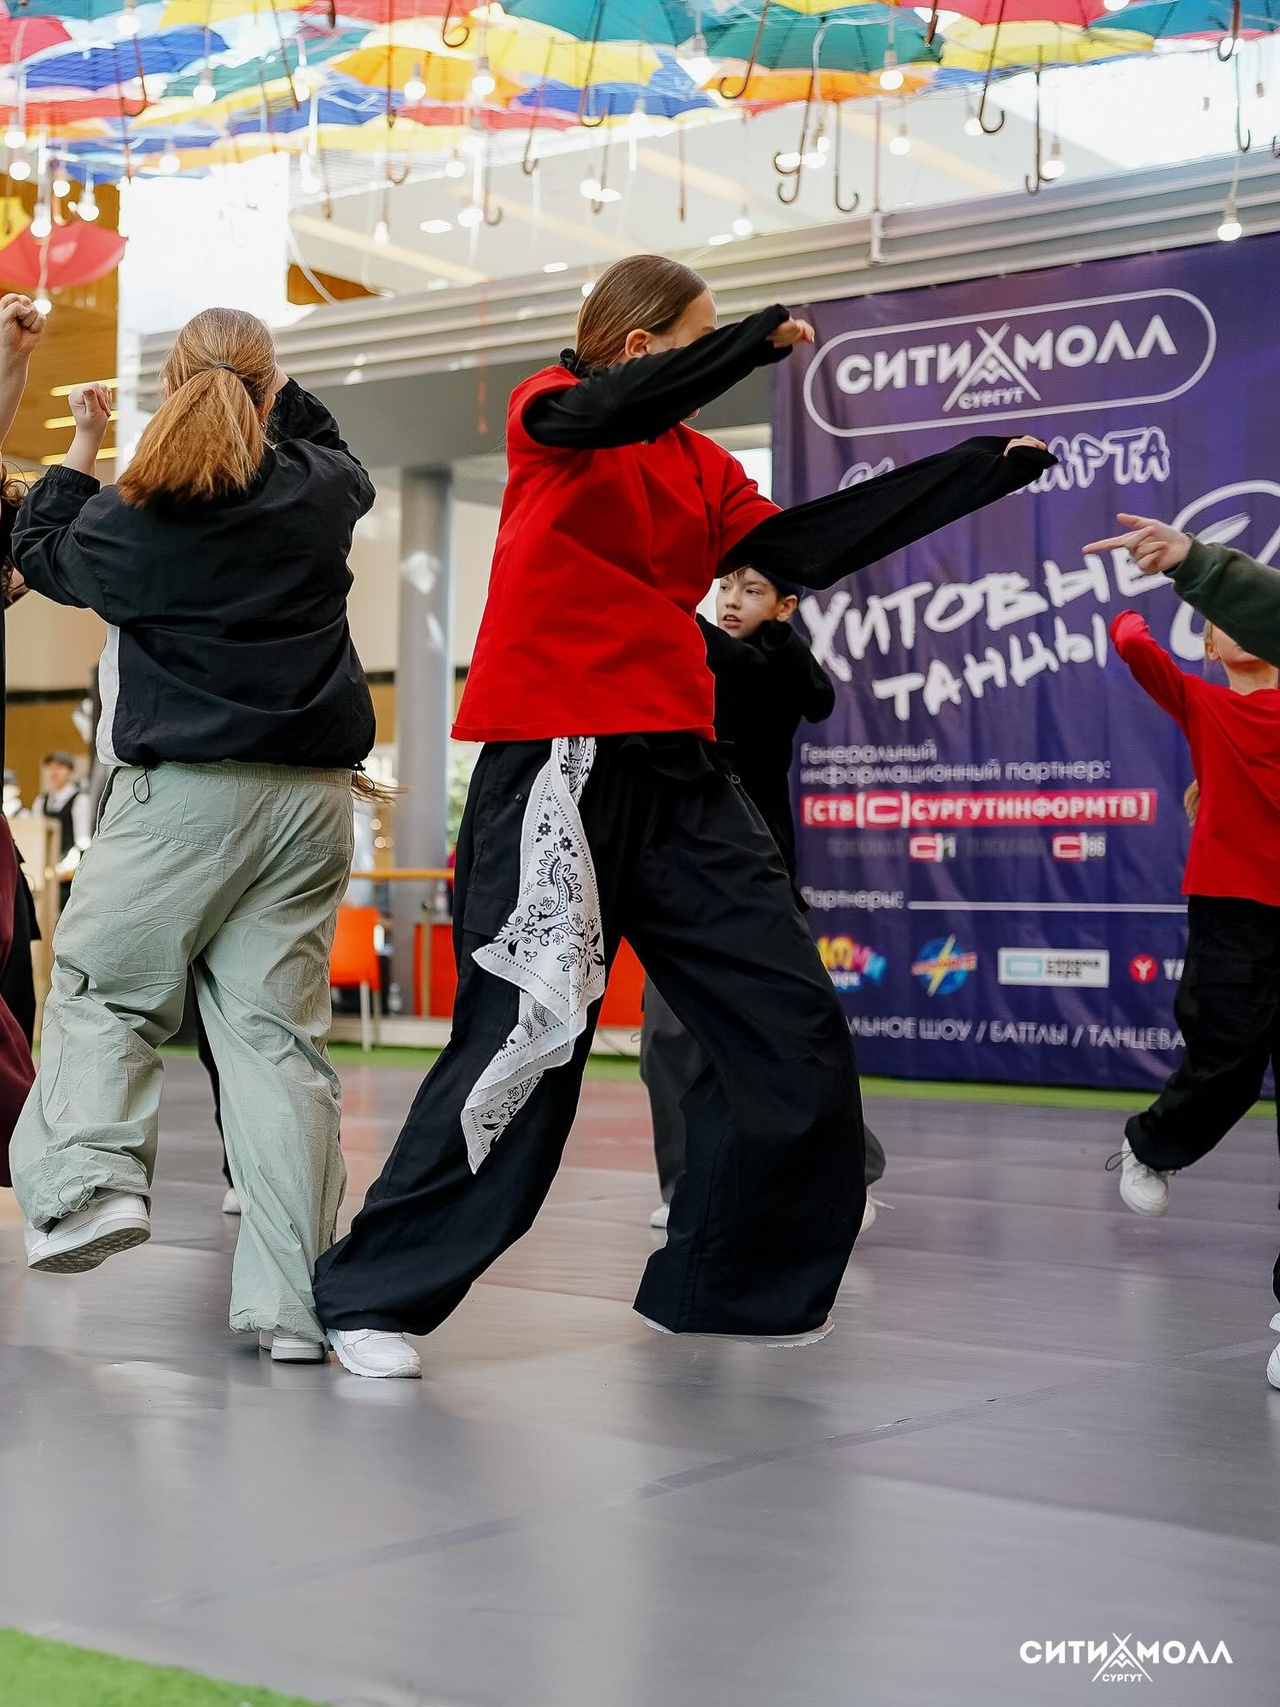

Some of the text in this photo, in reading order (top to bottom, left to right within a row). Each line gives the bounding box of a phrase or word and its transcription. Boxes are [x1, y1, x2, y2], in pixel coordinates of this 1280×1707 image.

[835, 314, 1178, 395] СИТИ МОЛЛ
[957, 385, 1026, 409] СУРГУТ
[1007, 425, 1171, 496] АРТА
[799, 547, 1176, 682] ХИТОВЫЕ
[872, 613, 1109, 721] ТАНЦЫ
[801, 739, 938, 764] Генеральный
[919, 1018, 972, 1041] ШОУ
